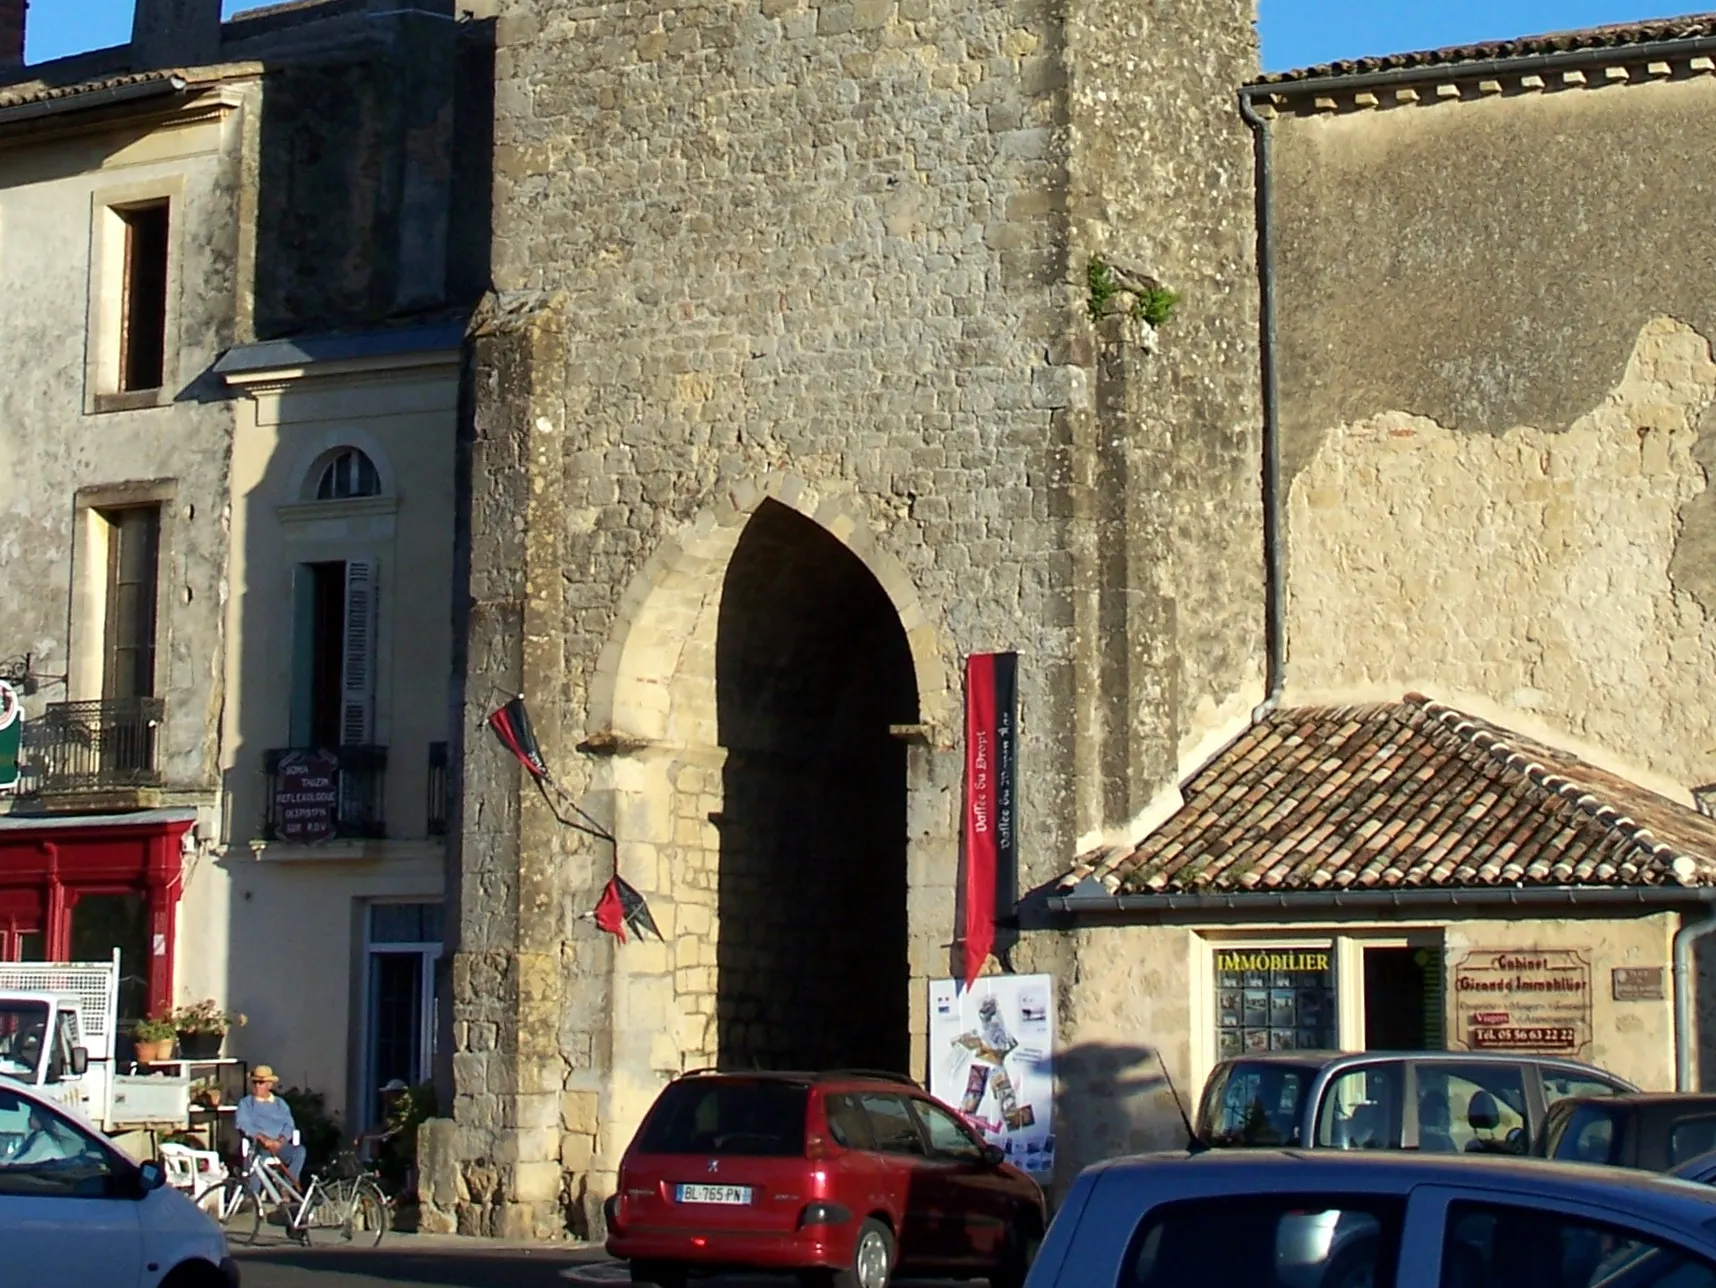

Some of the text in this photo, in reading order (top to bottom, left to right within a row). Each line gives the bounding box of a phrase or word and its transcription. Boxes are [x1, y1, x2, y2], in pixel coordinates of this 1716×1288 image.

[1217, 953, 1329, 971] IMMOBILIER
[1491, 954, 1548, 971] Cabinet
[1516, 976, 1587, 992] Immobilier
[1498, 1029, 1511, 1040] 05
[1514, 1029, 1527, 1040] 56
[1530, 1029, 1542, 1040] 63
[1545, 1029, 1557, 1040] 22
[1561, 1029, 1573, 1040] 22
